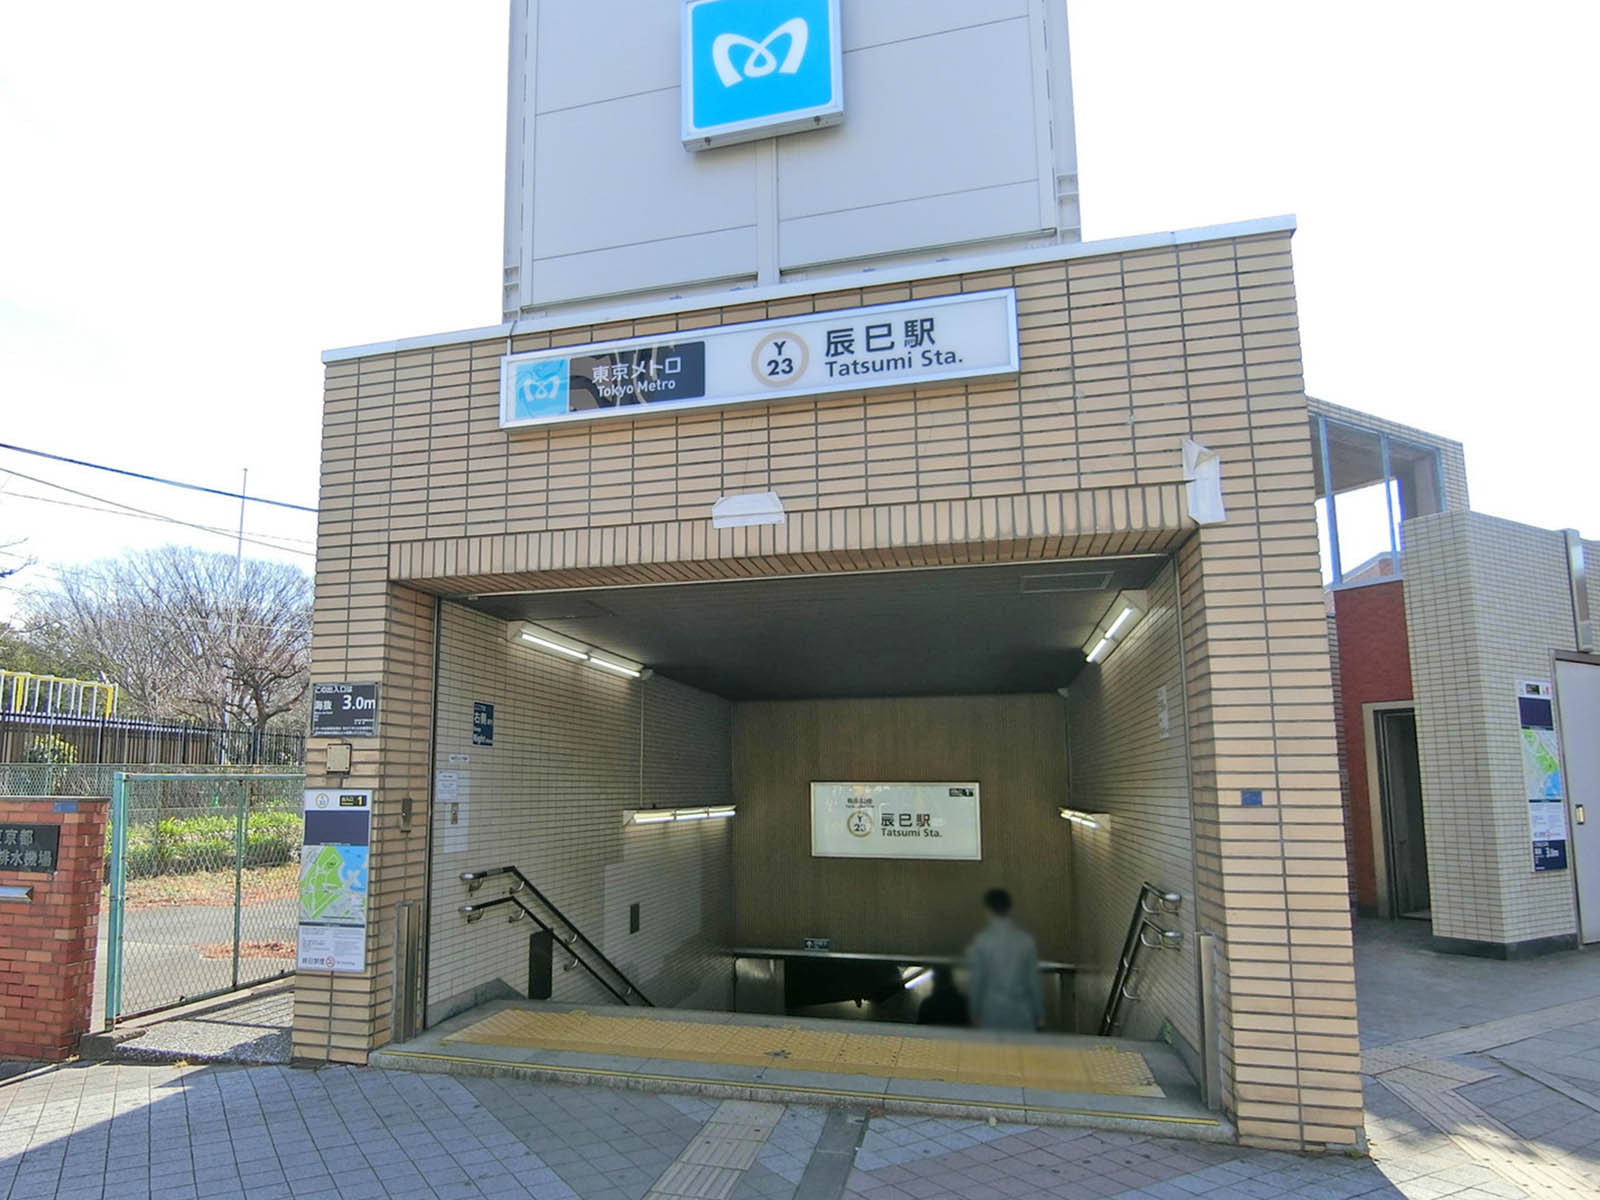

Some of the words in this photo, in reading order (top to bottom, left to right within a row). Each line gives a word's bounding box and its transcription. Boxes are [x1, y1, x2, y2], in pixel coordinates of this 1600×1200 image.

[825, 317, 936, 358] 辰巳駅
[773, 340, 786, 356] Y
[591, 356, 681, 384] 東京メトロ
[767, 357, 794, 377] 23
[825, 351, 913, 378] Tatsumi
[921, 349, 963, 368] Sta.
[597, 384, 634, 398] Tokyo
[637, 379, 676, 393] Metro
[342, 694, 376, 710] 3.0m
[881, 812, 931, 827] 辰巳駅
[881, 828, 920, 837] Tatsumi
[923, 828, 943, 838] Sta.
